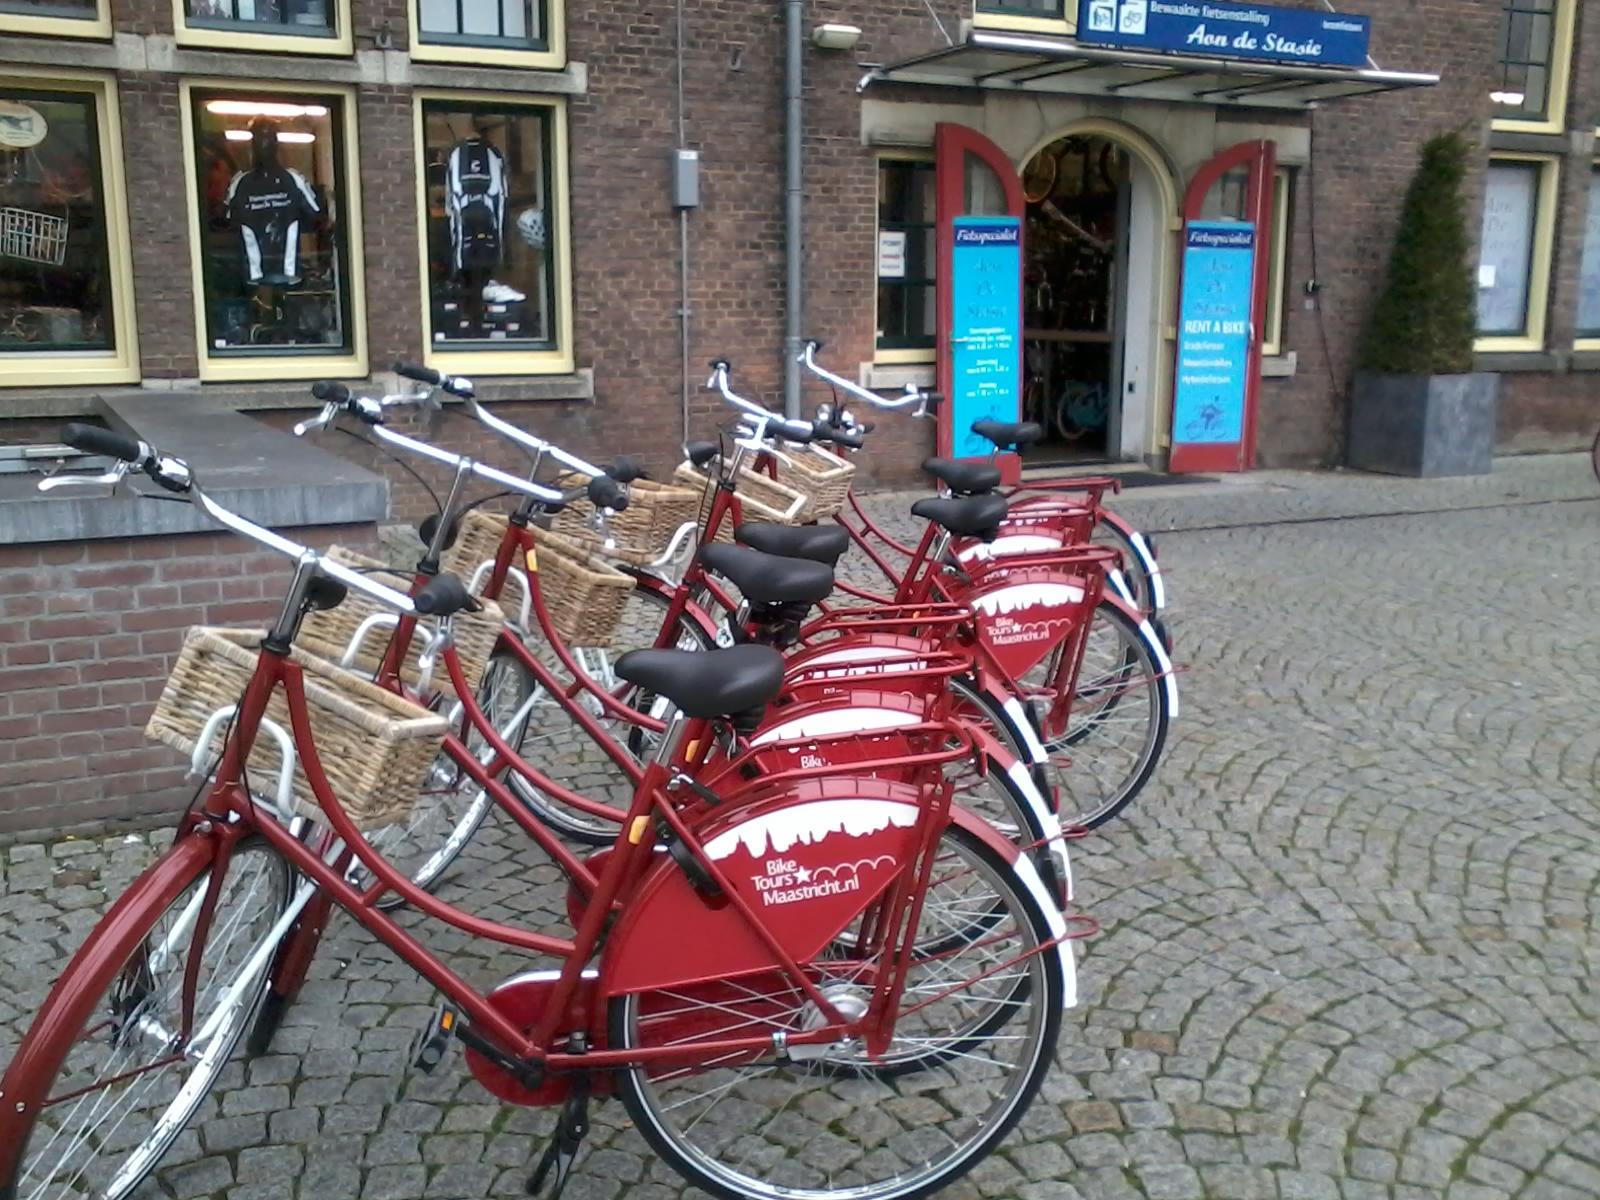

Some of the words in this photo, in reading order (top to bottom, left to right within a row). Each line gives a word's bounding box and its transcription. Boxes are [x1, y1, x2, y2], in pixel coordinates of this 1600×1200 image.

[1186, 23, 1229, 47] Aon
[1232, 30, 1258, 50] de
[1261, 32, 1323, 56] Stasie
[1184, 320, 1211, 333] RENT
[1213, 320, 1222, 333] A
[1223, 321, 1245, 334] BIKE
[986, 625, 1012, 637] Tours
[995, 617, 1014, 627] Bike
[993, 627, 1050, 646] Maastricht.nl
[766, 857, 798, 876] Bike
[752, 874, 794, 891] Tours
[763, 875, 859, 906] Maastricht.nl
